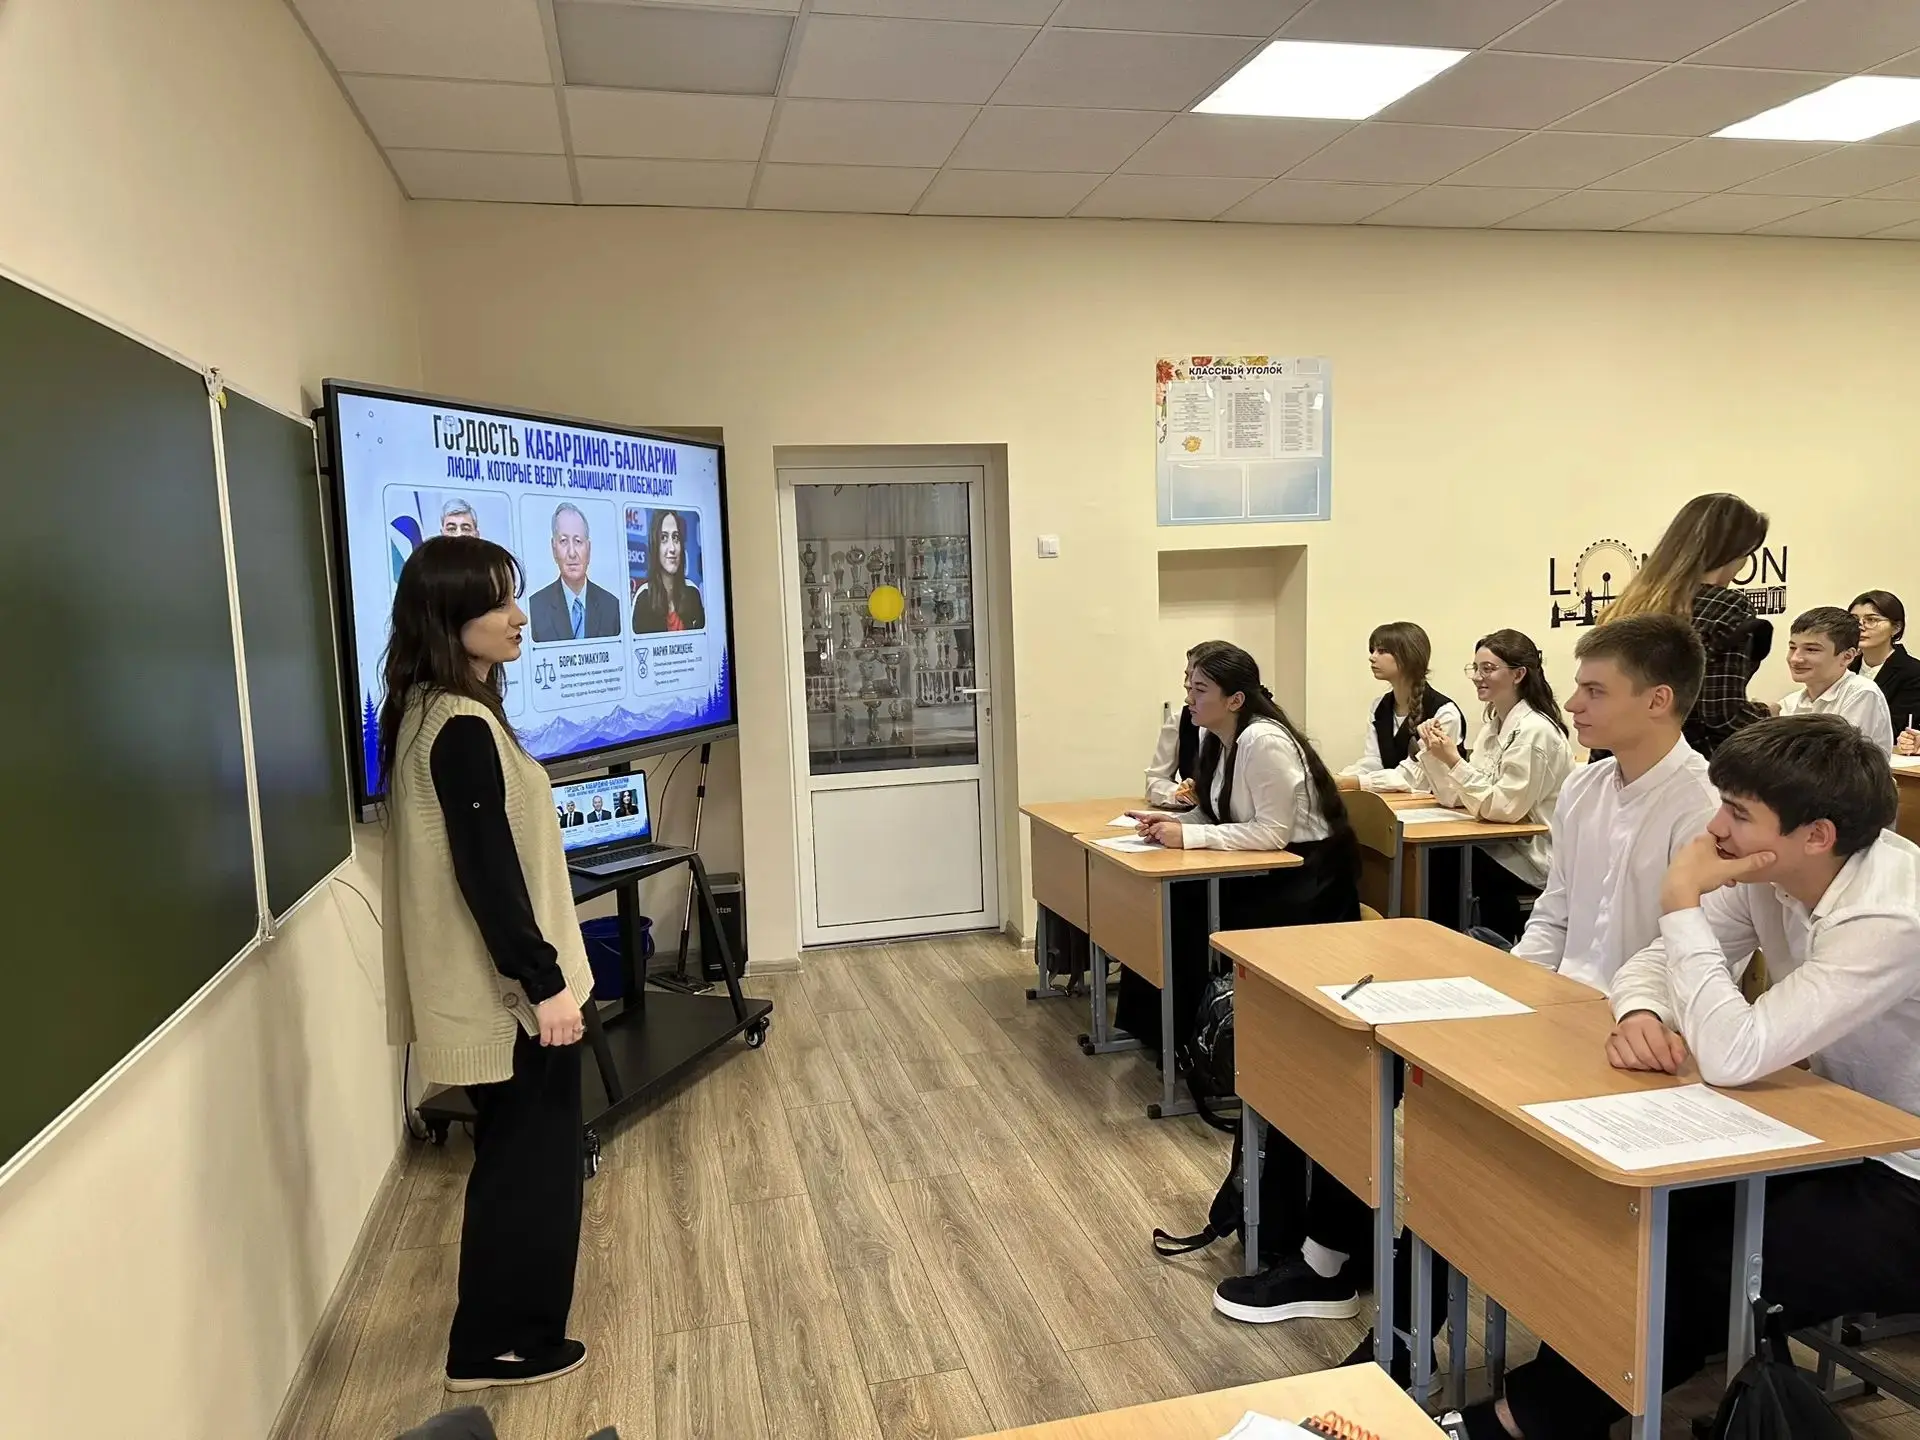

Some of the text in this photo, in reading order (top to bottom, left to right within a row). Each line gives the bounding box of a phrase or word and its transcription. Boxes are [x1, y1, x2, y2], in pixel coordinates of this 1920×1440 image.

[1189, 366, 1283, 375] КЛАССНЫЙ УГОЛОК
[433, 414, 677, 475] ГОРДОСТЬ КАБАРДИНО-БАЛКАРИИ
[447, 456, 673, 497] ЛЮДИ, КОТОРЫЕ ВЕДУТ, ЗАЩИЩАЮТ И ПОБЕЖДАЮТ
[559, 651, 610, 668] БОРИС ЗУМАКУЛОВ
